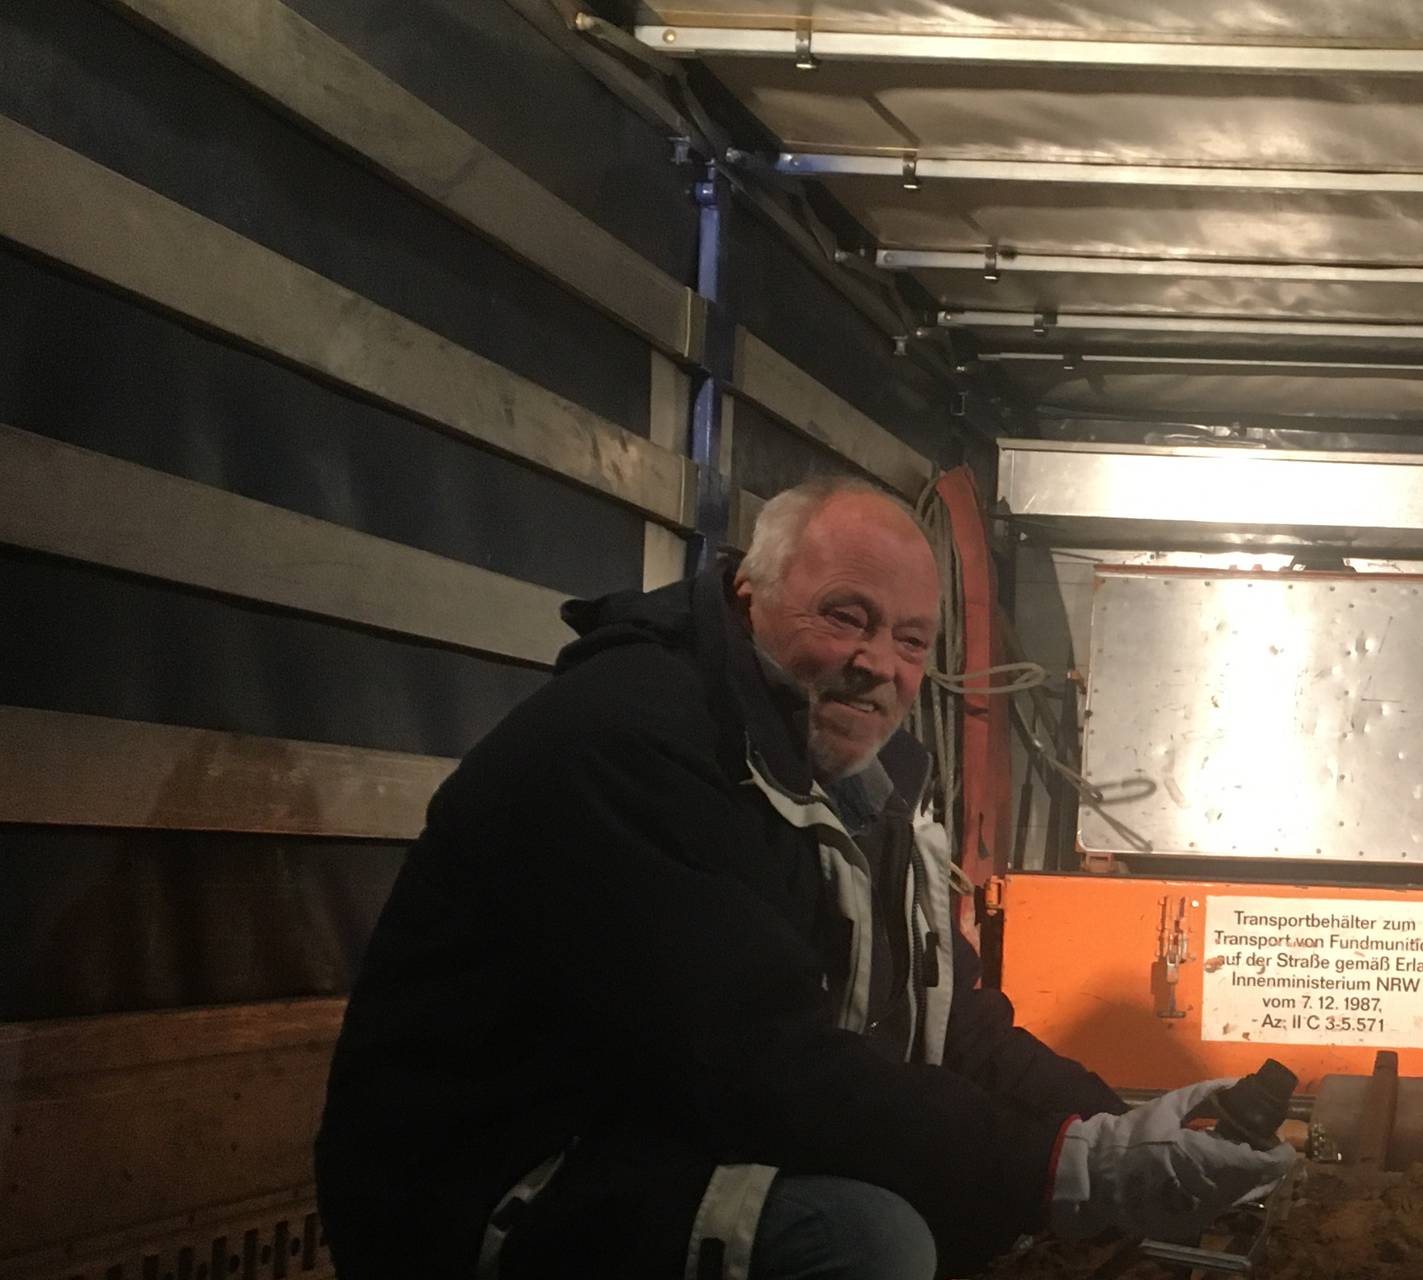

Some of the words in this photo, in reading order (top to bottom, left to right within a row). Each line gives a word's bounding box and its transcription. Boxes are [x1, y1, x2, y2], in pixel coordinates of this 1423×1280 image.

[1234, 910, 1377, 930] Transportbehälter
[1382, 918, 1416, 931] zum
[1214, 930, 1291, 948] Transport
[1295, 936, 1324, 948] von
[1217, 952, 1242, 966] auf
[1246, 952, 1271, 967] der
[1276, 952, 1330, 969] Straße
[1335, 955, 1390, 973] gemäß
[1231, 971, 1371, 991] Innenministerium
[1376, 977, 1421, 993] NRW
[1262, 997, 1296, 1009] vom
[1301, 996, 1313, 1009] 7.
[1318, 996, 1339, 1010] 12.
[1306, 1015, 1320, 1031] C
[1325, 1016, 1385, 1032] 3-5.571
